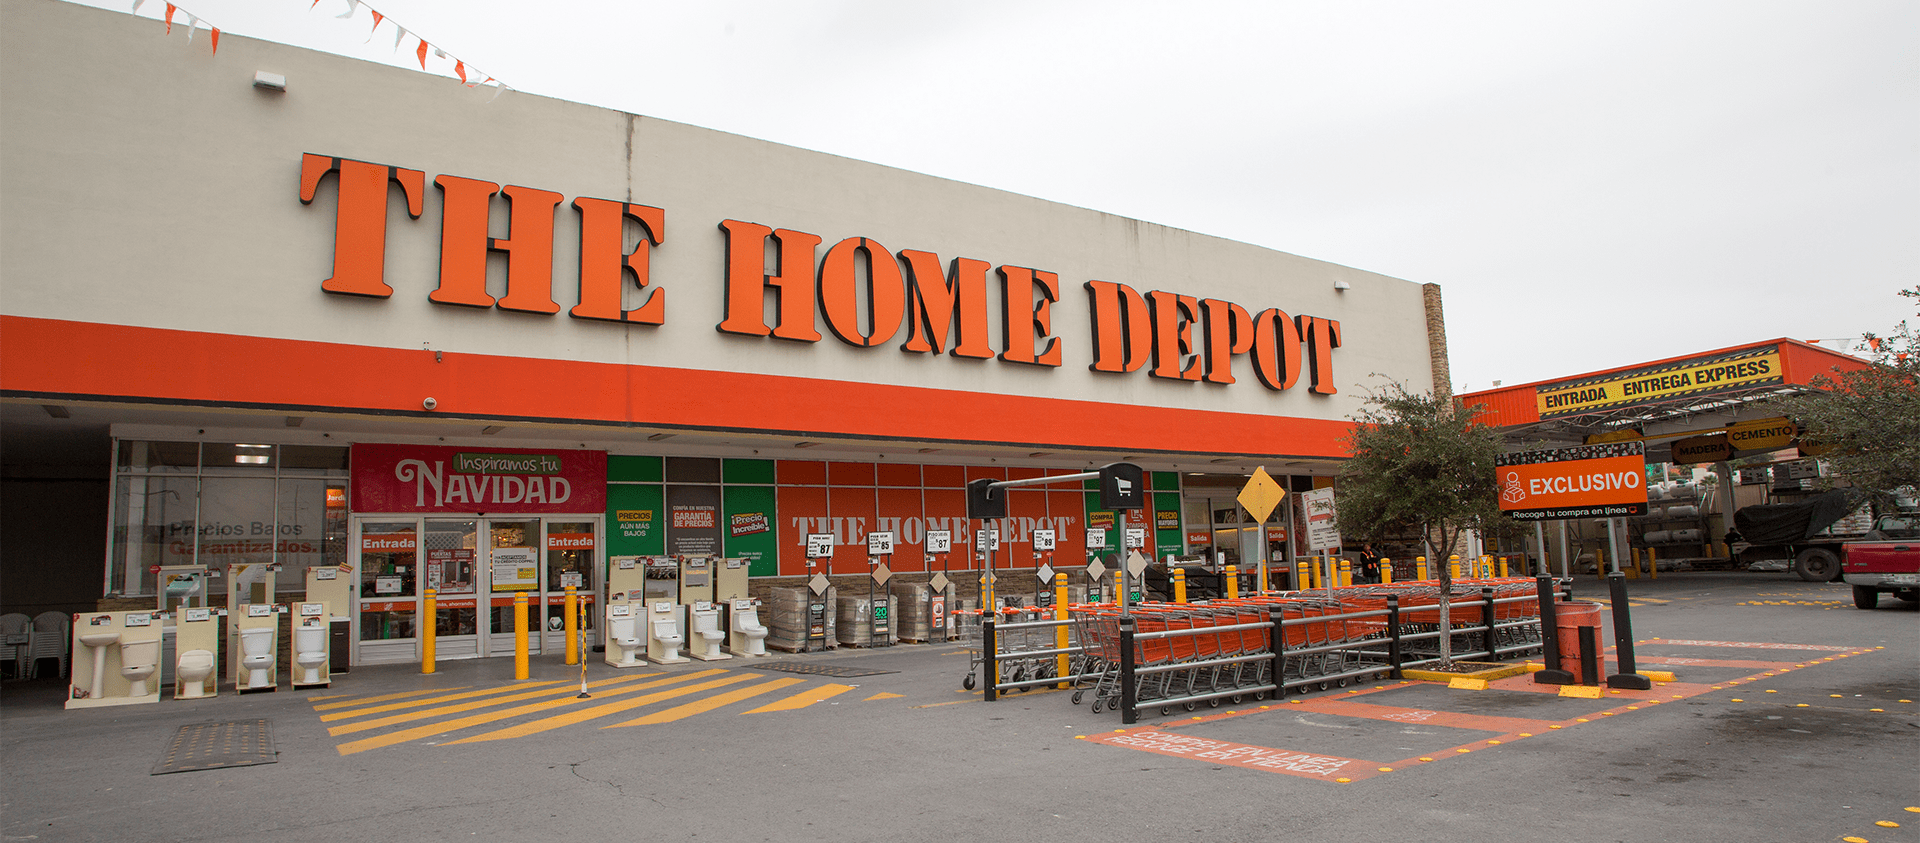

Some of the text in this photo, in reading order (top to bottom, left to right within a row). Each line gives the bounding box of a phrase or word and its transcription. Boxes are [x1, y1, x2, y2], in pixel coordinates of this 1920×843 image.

[300, 152, 1341, 396] THE HOME DEPOT
[1545, 359, 1770, 408] ENTRADA ENTREGA EXPRESS
[1732, 426, 1792, 441] CEMENTO
[1680, 444, 1726, 456] MADERA
[459, 454, 558, 475] Inspiramos tu
[395, 459, 571, 507] NAVIDAD
[1529, 471, 1640, 495] EXCLUSIVO
[674, 510, 711, 520] GARANTÍA
[1512, 511, 1545, 520] Recoge
[1546, 509, 1555, 518] tu
[1557, 509, 1590, 519] compra
[620, 521, 650, 530] AÚN MÁS
[792, 516, 867, 546] THE
[362, 538, 416, 549] Entrada
[548, 537, 594, 547] Entrada
[875, 607, 887, 617] 20
[1133, 732, 1229, 750] COMPRA
